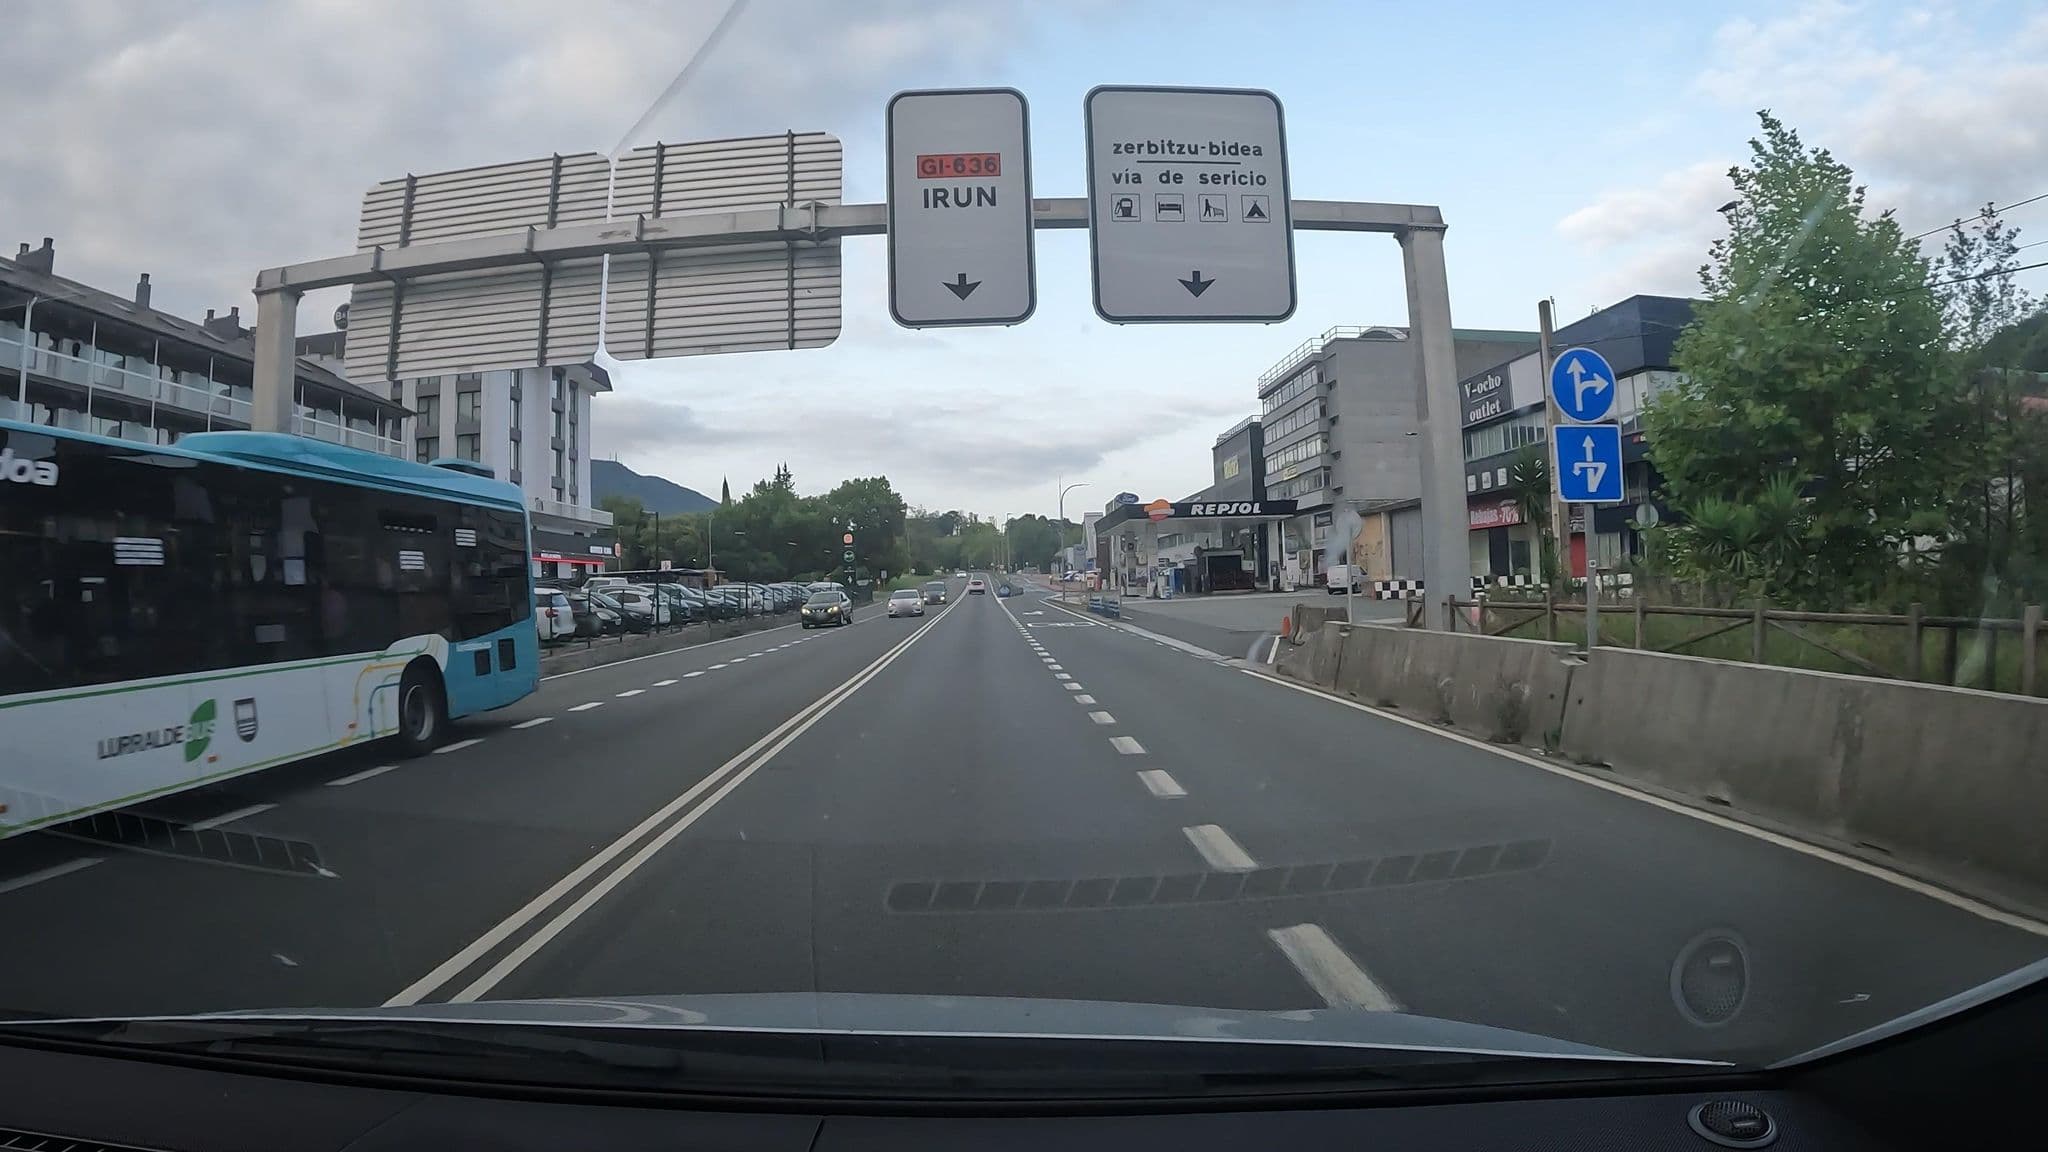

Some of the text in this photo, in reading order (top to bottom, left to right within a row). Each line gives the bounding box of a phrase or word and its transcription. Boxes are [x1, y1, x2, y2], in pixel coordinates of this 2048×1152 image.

[1113, 139, 1262, 157] zerbitzu-bidea
[920, 157, 998, 176] GI-636
[1112, 167, 1267, 186] vía de sericio
[923, 187, 997, 208] IRUN
[1464, 375, 1501, 398] V-ocho
[1470, 399, 1501, 421] outlet
[1191, 502, 1262, 516] REPSOL
